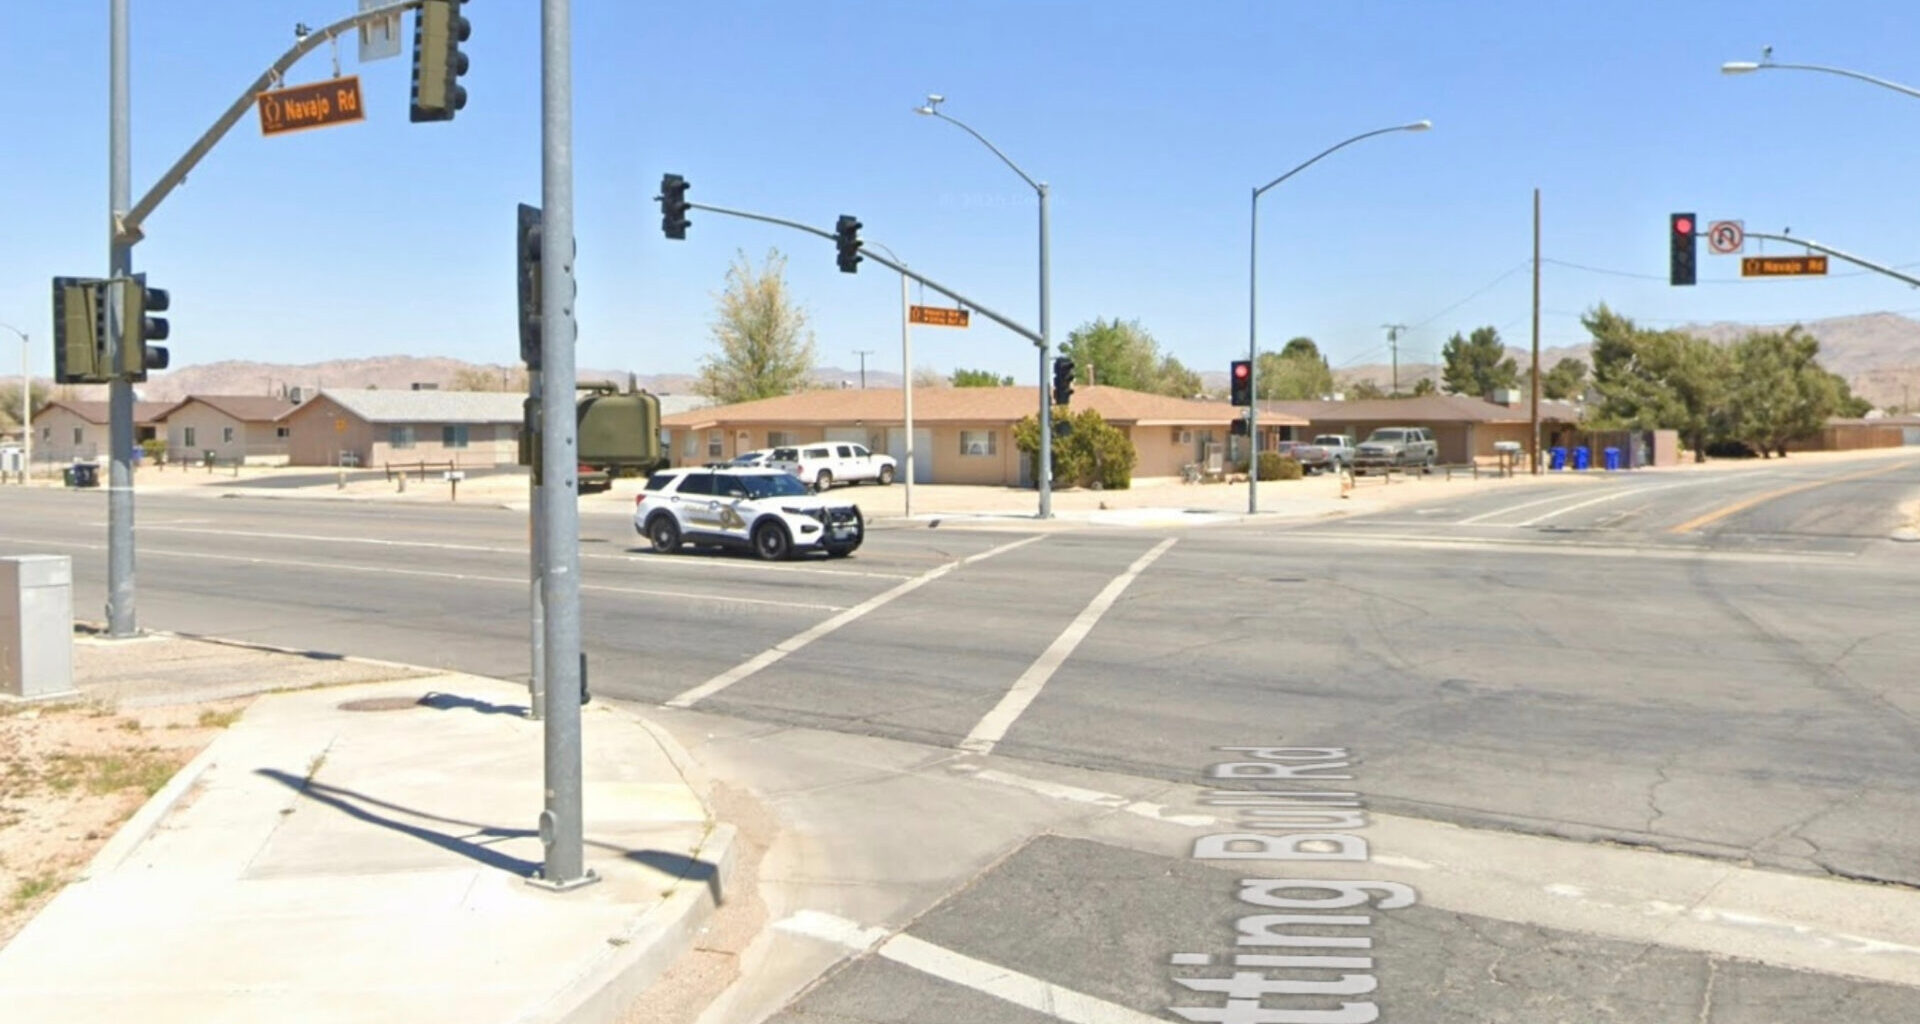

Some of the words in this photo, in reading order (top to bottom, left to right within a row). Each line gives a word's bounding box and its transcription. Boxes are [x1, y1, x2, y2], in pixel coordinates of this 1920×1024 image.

[284, 93, 330, 121] Navajo
[336, 88, 356, 112] Rd
[1763, 260, 1802, 274] Navajo
[1807, 259, 1824, 271] Rd
